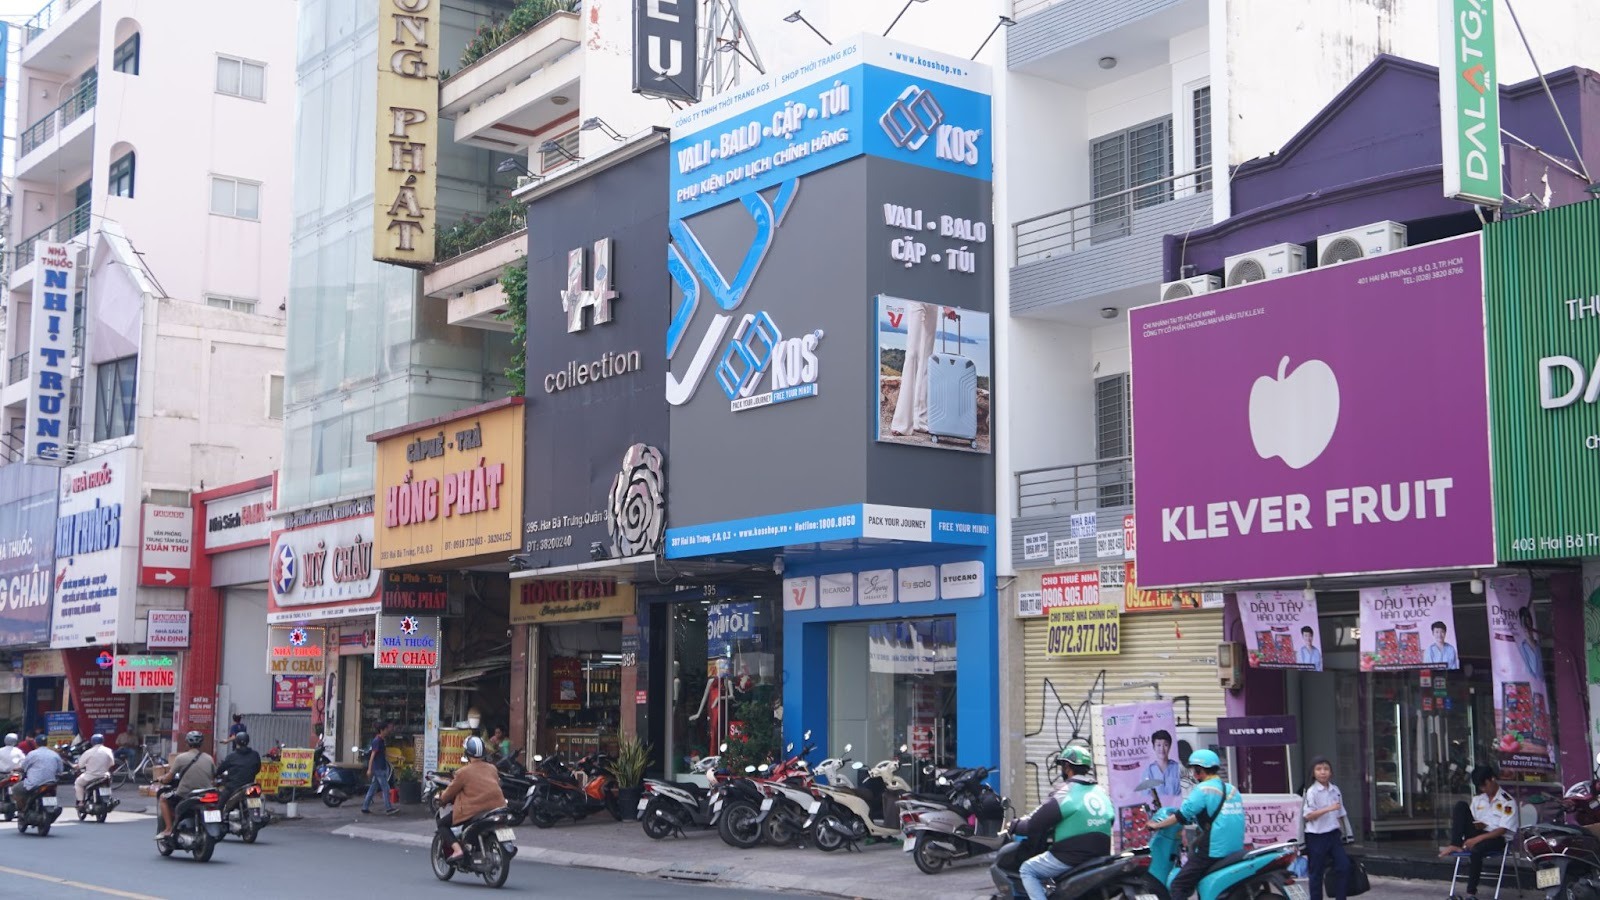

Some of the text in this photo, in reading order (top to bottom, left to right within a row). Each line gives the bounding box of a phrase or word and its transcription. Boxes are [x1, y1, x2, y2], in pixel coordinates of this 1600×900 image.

[781, 69, 799, 83] SHOP
[817, 51, 841, 67] TRANG
[842, 44, 857, 57] KOS
[896, 51, 961, 76] www.kosshop.vn
[675, 115, 692, 128] CÔNG
[692, 111, 701, 119] TY
[701, 105, 718, 117] TNHH
[733, 88, 755, 103] TRANG
[756, 82, 770, 94] KOS
[677, 79, 850, 175] VALI BALO CẶP TÚI
[936, 123, 978, 166] KOS
[387, 107, 428, 251] PHÁT
[676, 183, 701, 203] PHỤ
[700, 173, 726, 195] KIỆN
[726, 166, 744, 184] DU
[745, 156, 773, 180] LỊCH
[773, 140, 811, 166] CHÍNH
[883, 203, 987, 243] VALI BALO
[41, 256, 73, 269] THUỐC
[47, 247, 68, 257] NHÀ
[891, 235, 975, 273] CẶP TÚI
[1447, 257, 1464, 266] HCM
[544, 350, 641, 393] collection
[772, 334, 818, 390] KOS
[732, 400, 743, 409] PACK
[743, 398, 753, 407] YOUR
[753, 395, 772, 405] JOURNEY
[773, 392, 785, 401] FREE
[786, 388, 797, 398] YOUR
[73, 462, 112, 494] NHÀ THUỐC
[385, 457, 504, 528] HỒNG PHÁT
[1161, 493, 1313, 543] KLEVER
[1325, 477, 1453, 527] FRUIT
[223, 513, 241, 529] Sách
[739, 524, 787, 537] www.kosshop.vn
[795, 520, 819, 532] Hotline:
[868, 516, 990, 534] PACK YOUR JOURNEY FREE YOUR MIND!
[9, 530, 33, 559] THUỐC
[145, 543, 188, 553] XUÂN THU
[540, 535, 572, 550] 38200240
[1512, 534, 1584, 551] 403 Hai Bà
[302, 533, 373, 588] MỸ CHÂU
[9, 563, 50, 611] CHÂU
[1042, 576, 1058, 586] CHO
[1059, 573, 1079, 584] THUÊ
[1081, 572, 1098, 582] NHÀ
[703, 585, 716, 596] 395
[1043, 585, 1099, 607] 0906.905.006
[1250, 599, 1303, 613] DÂU TÂY
[1374, 593, 1436, 611] DÂU TÂY
[383, 635, 435, 648] NHÀ THUỐC
[1048, 623, 1118, 653] 0972.377.039
[130, 658, 146, 666] NHÀ
[272, 658, 323, 672] MỸ CHÂU
[380, 648, 437, 665] MỸ CHÂU
[622, 653, 635, 666] 393
[117, 671, 136, 690] NHỊ
[140, 667, 174, 687] TRƯNG
[1110, 734, 1150, 749] DÂU TÂY
[1266, 810, 1294, 824] TÂY
